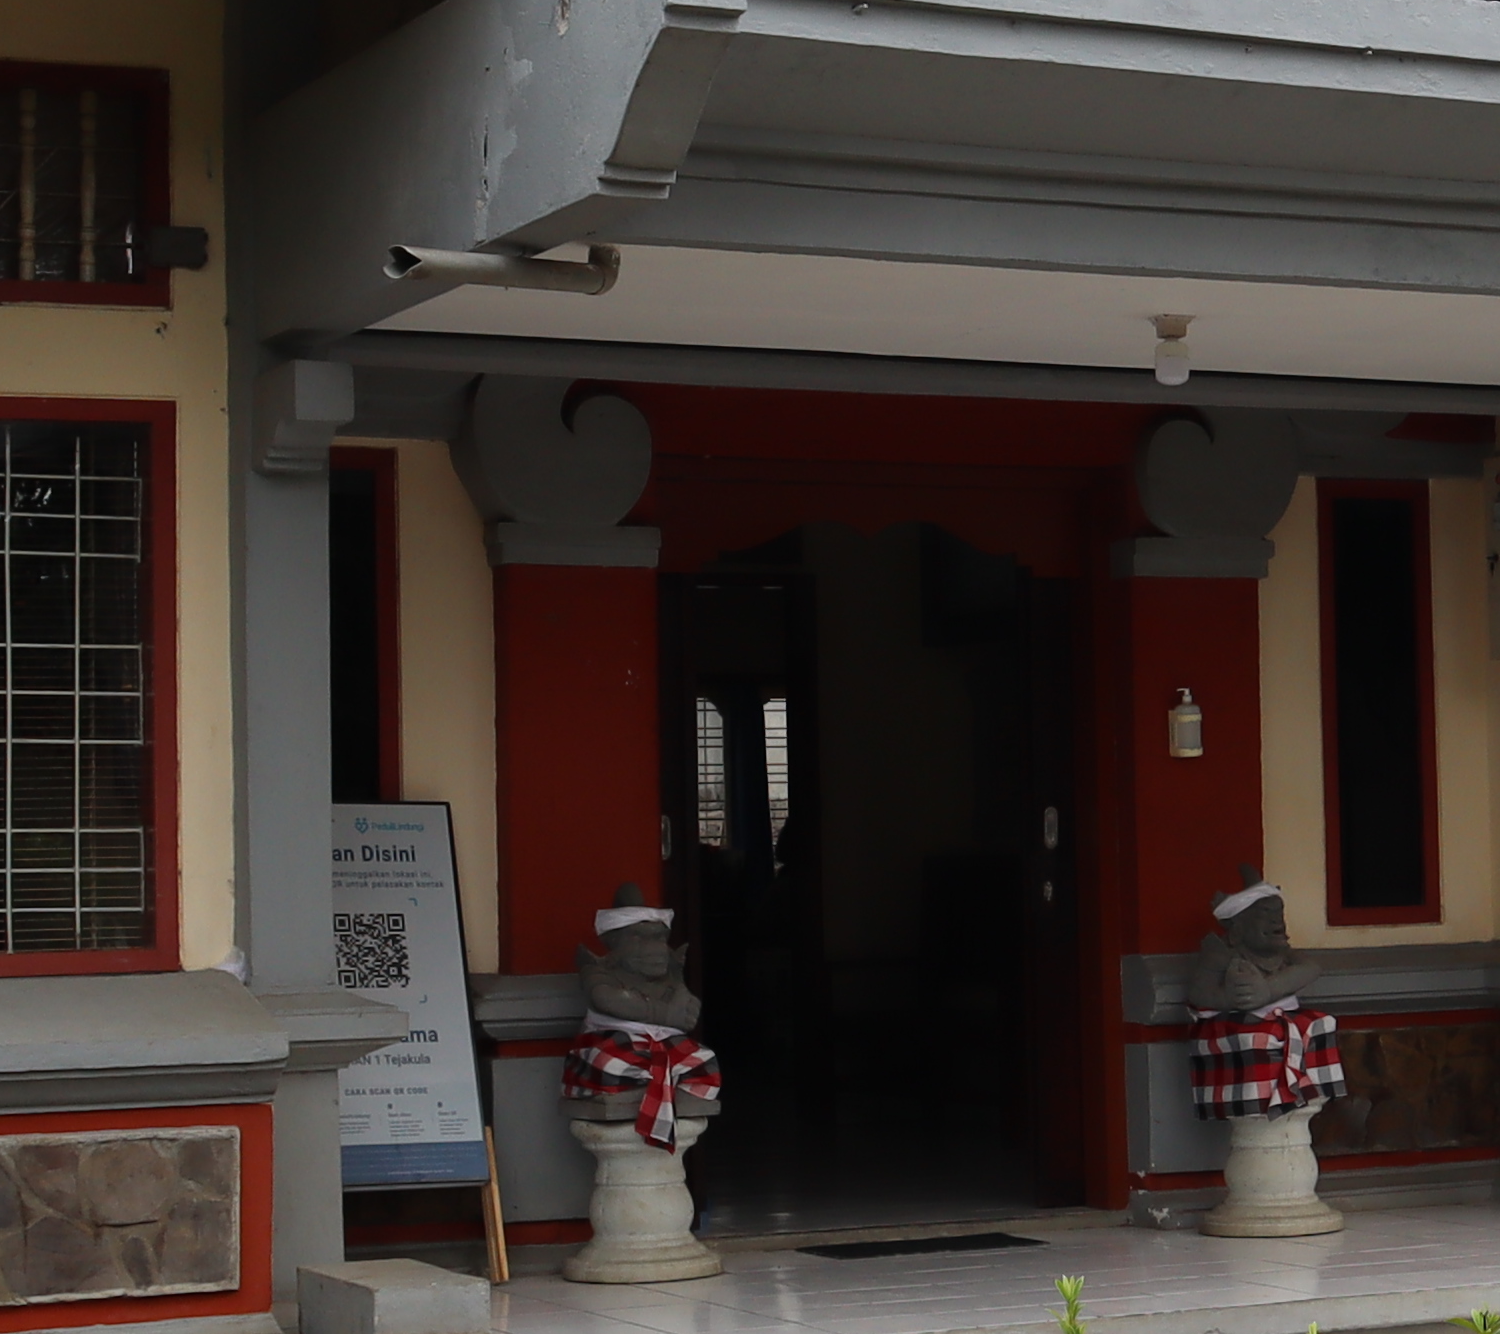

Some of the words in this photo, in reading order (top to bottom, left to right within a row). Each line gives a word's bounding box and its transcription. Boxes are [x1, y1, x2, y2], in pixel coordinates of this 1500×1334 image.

[332, 848, 354, 862] an
[362, 845, 416, 862] Disini
[352, 1055, 371, 1065] AN
[374, 1056, 380, 1064] 1
[384, 1054, 431, 1067] Tejakula
[345, 1088, 366, 1096] CARA
